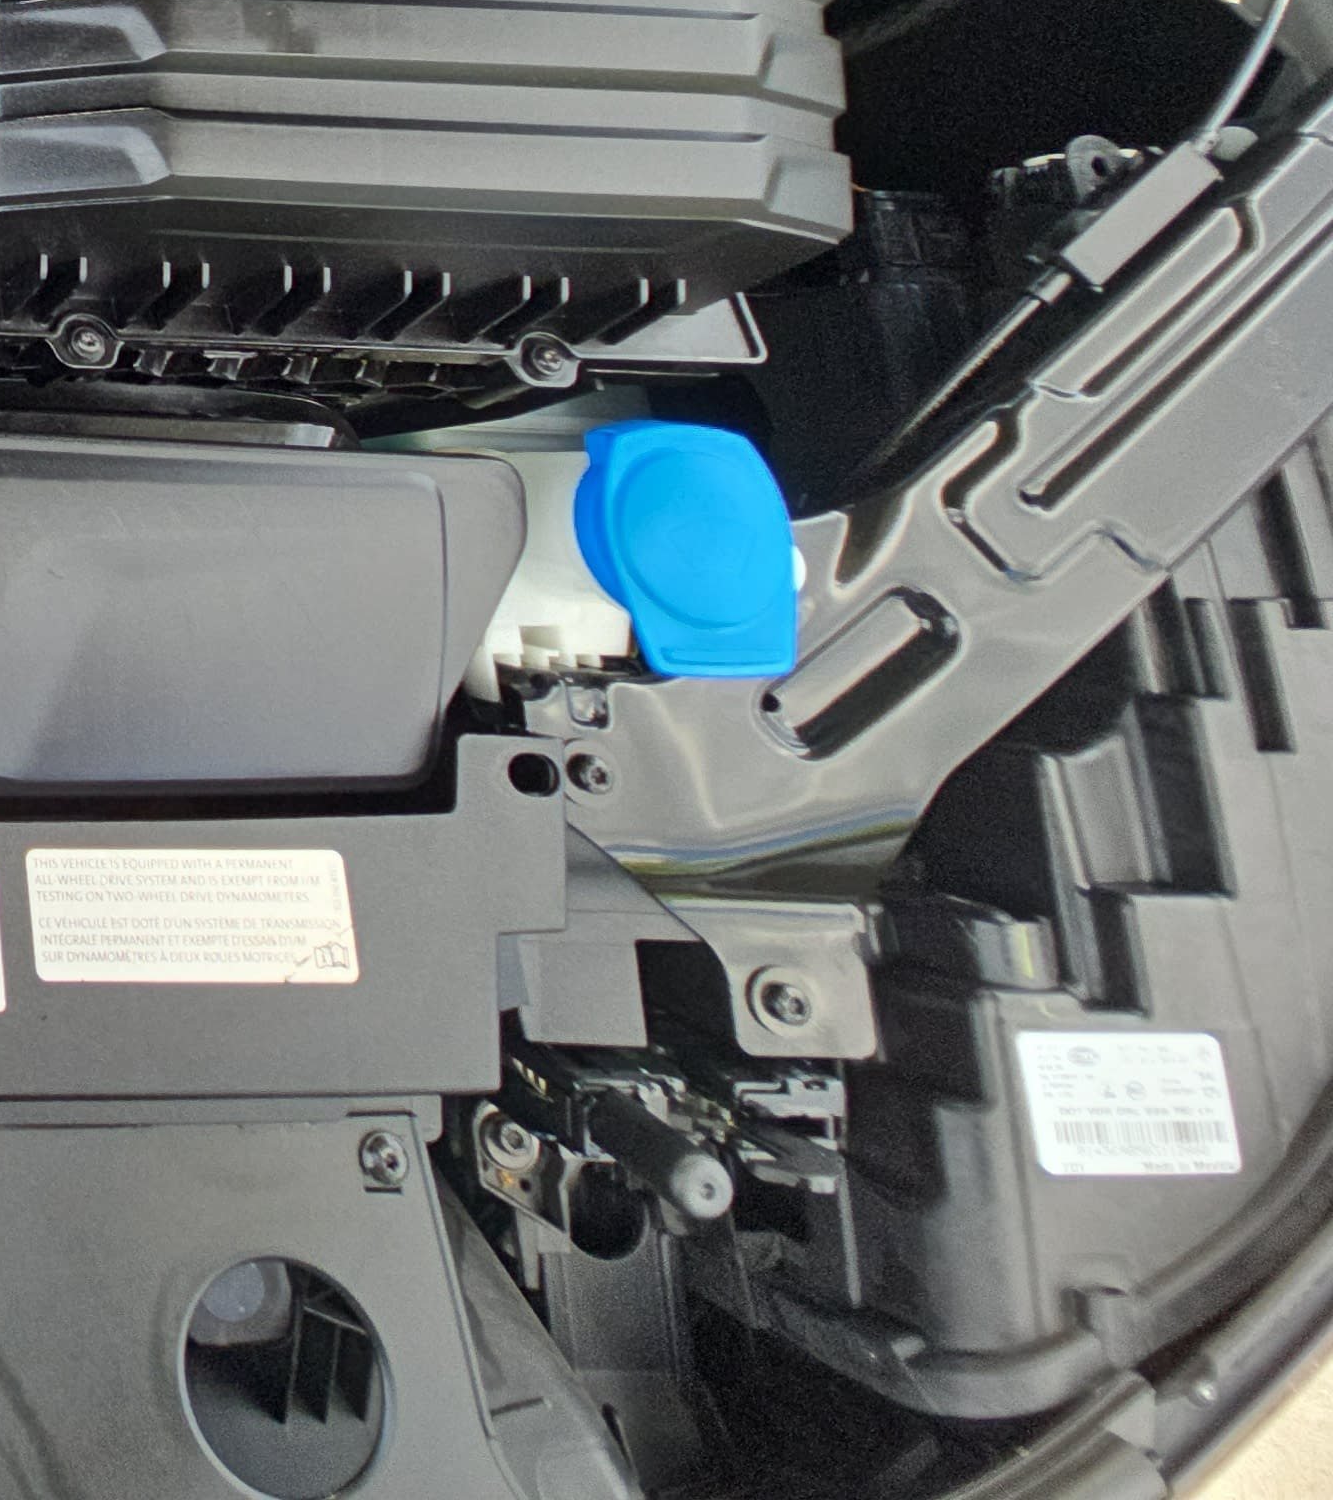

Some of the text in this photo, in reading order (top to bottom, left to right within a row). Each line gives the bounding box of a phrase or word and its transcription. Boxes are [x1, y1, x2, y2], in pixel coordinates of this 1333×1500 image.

[33, 858, 293, 871] THIS VEHICLE IS EQUIPPED WITH A PERMANENT
[99, 874, 133, 885] DRIVE
[135, 874, 177, 886] SYSTEM
[180, 875, 206, 886] AND
[208, 875, 218, 886] IS
[221, 875, 263, 886] EXEMPT
[267, 875, 299, 886] FROM
[36, 890, 82, 902] TESTING
[85, 890, 103, 902] ON
[180, 891, 213, 902] DRIVE
[38, 916, 52, 929] CE
[111, 916, 129, 929] EST
[243, 918, 258, 930] DE
[100, 934, 165, 946] PERMANENT
[168, 934, 180, 946] ET
[41, 951, 63, 963] SUR
[160, 949, 169, 963] À
[170, 951, 200, 963] DEUX
[203, 951, 239, 963] ROUES
